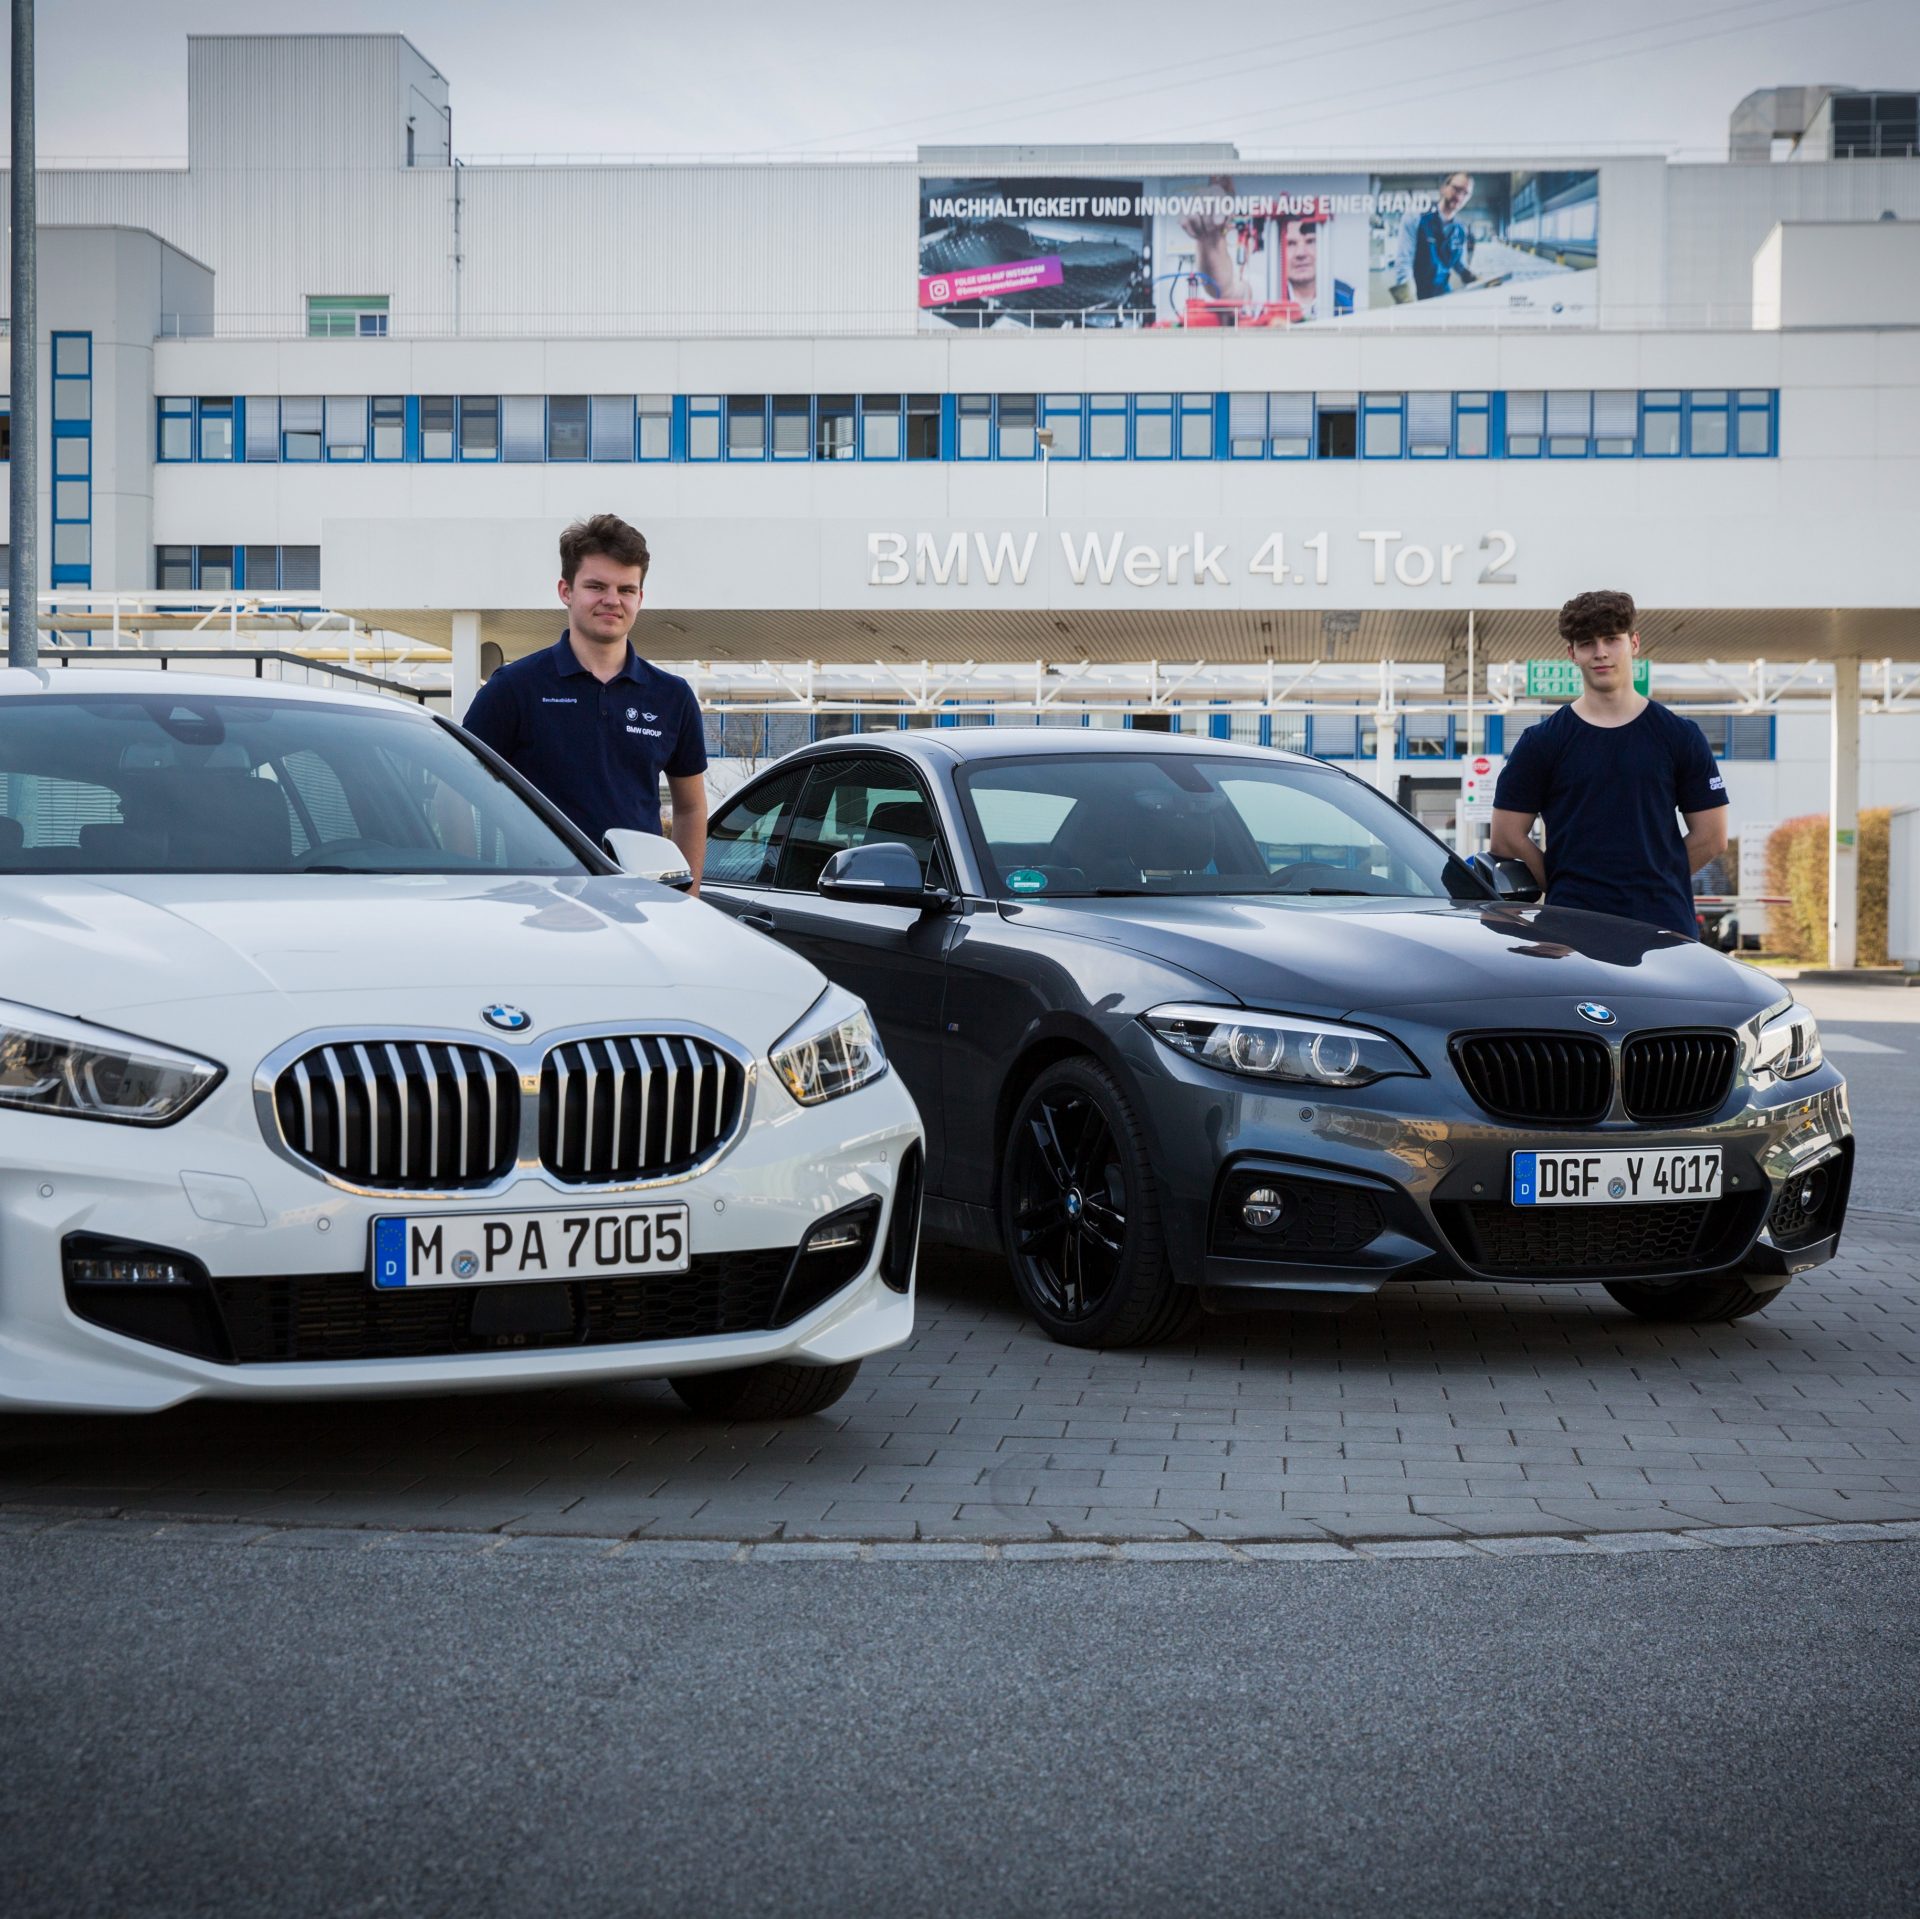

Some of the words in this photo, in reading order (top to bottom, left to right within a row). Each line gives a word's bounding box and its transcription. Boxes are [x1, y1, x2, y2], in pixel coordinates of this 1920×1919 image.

[929, 197, 1089, 218] NACHHALTIGKEIT
[1091, 196, 1132, 217] UND
[1134, 195, 1272, 216] INNOVATIONEN
[1276, 194, 1315, 215] AUS
[1318, 194, 1375, 215] EINER
[1378, 193, 1438, 213] HAND.
[1005, 264, 1045, 279] INSTAGRAM
[867, 531, 1038, 585] BMW
[1060, 531, 1231, 587] Werk
[1248, 531, 1329, 585] 4.1
[1357, 530, 1464, 586] Tor
[1477, 530, 1518, 584] 2
[626, 725, 642, 734] BMW
[642, 728, 662, 738] GROUP
[1539, 1158, 1601, 1198] DGF
[1627, 1157, 1643, 1195] Y
[1653, 1154, 1720, 1195] 4017
[1521, 1184, 1530, 1195] D
[412, 1225, 443, 1276] M
[483, 1221, 547, 1273] PA
[563, 1212, 682, 1267] 7005
[386, 1261, 397, 1276] D
